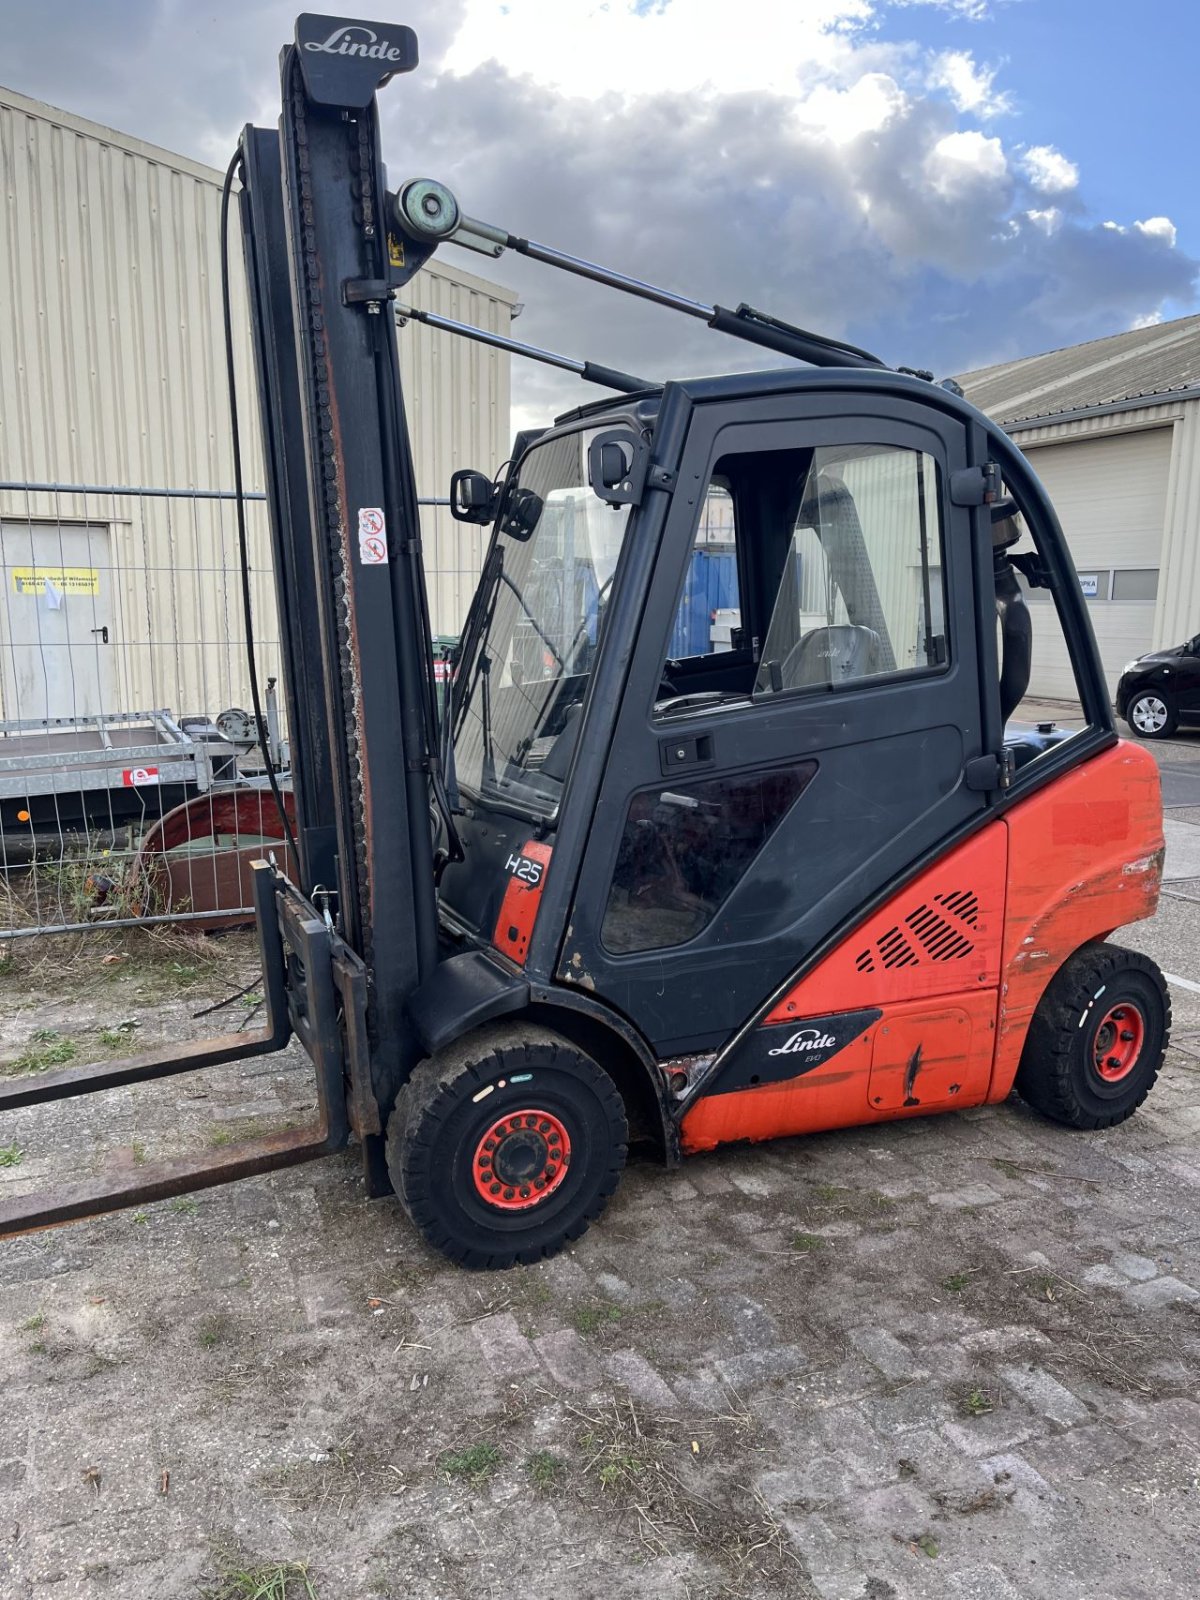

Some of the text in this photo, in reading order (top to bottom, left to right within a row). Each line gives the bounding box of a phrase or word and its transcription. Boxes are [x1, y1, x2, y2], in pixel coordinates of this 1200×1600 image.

[304, 26, 400, 61] Linde
[504, 853, 542, 883] H25
[768, 1029, 836, 1056] Linde
[804, 1054, 822, 1063] EVO
